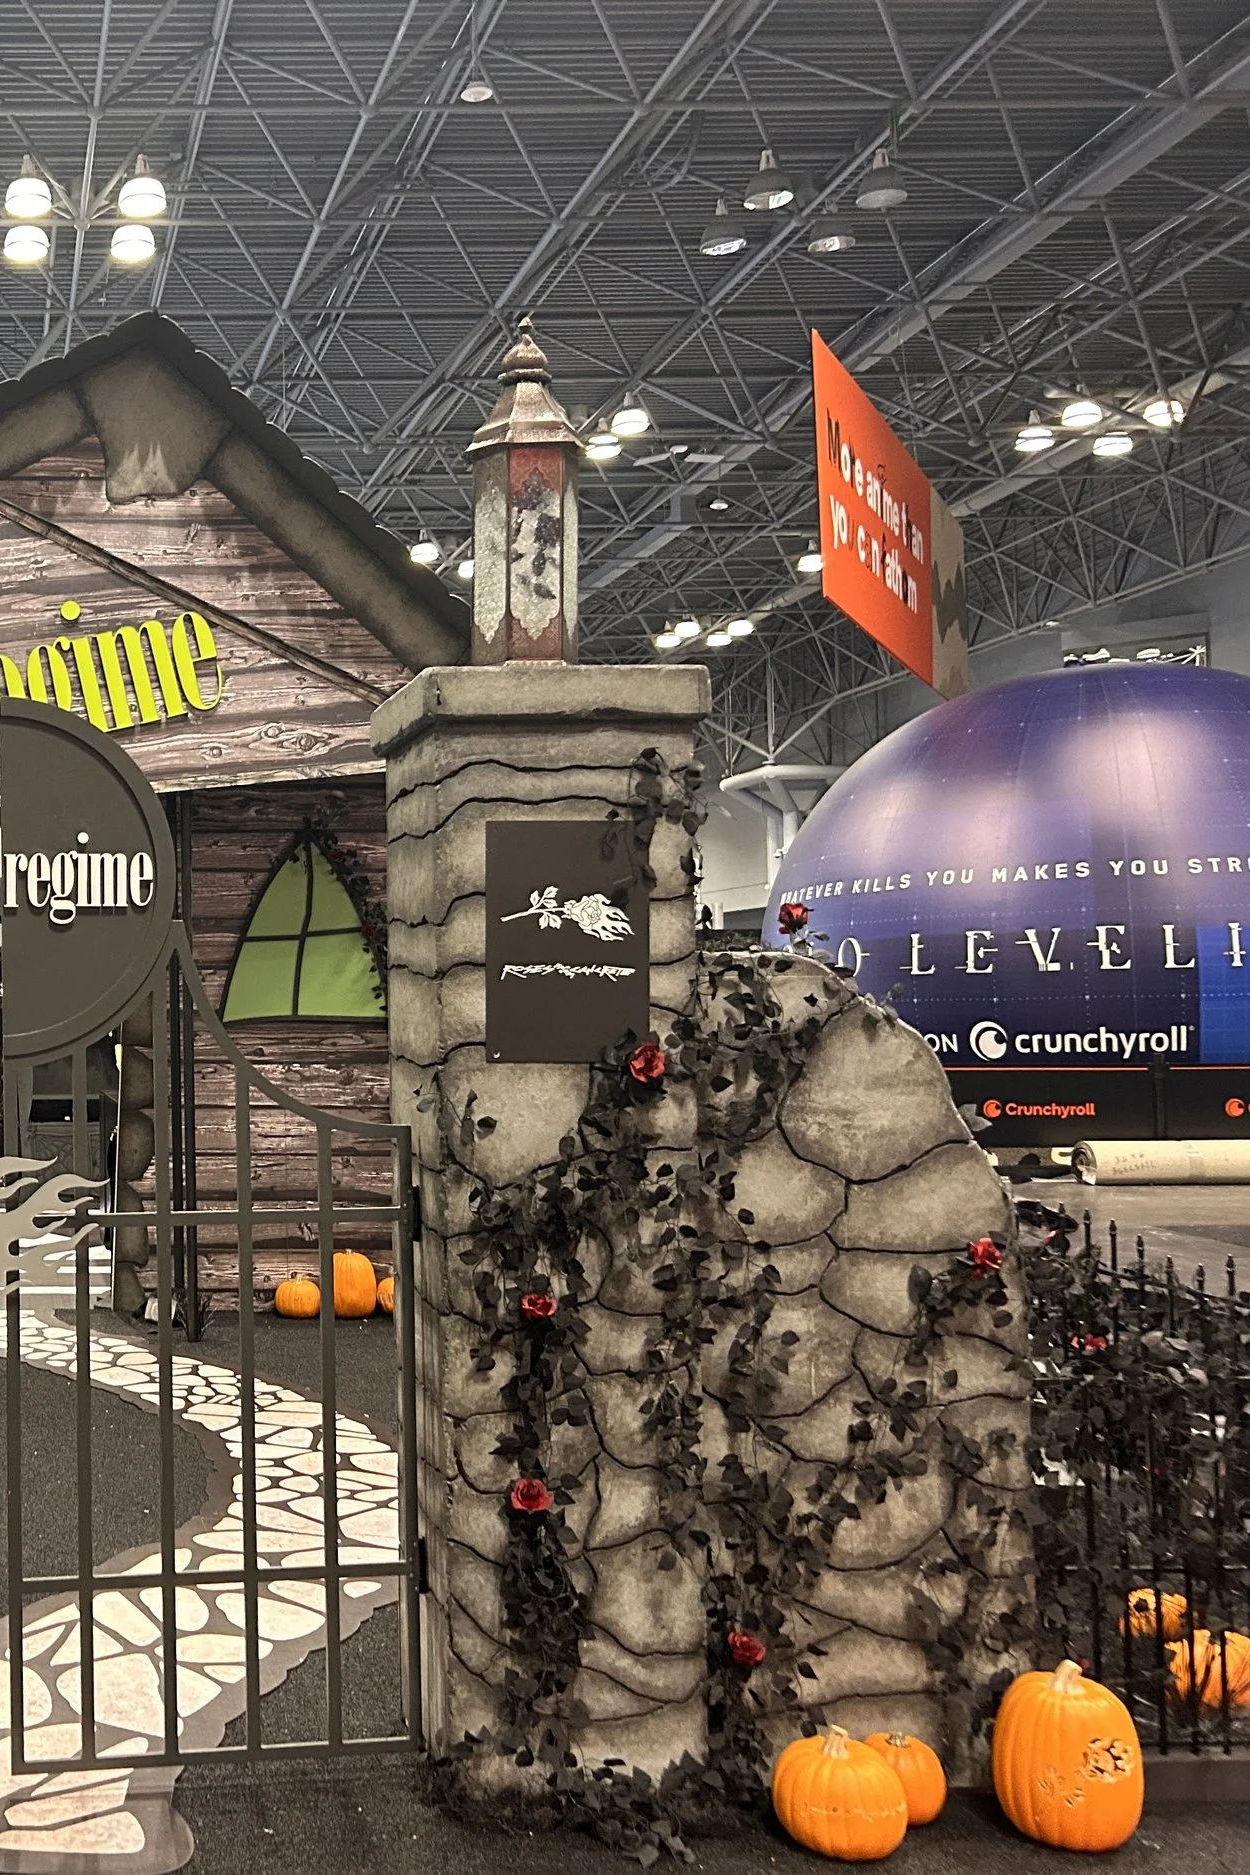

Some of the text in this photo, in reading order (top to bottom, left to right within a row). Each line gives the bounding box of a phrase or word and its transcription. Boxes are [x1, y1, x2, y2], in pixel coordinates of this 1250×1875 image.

[827, 408, 924, 565] More anime than
[829, 494, 918, 614] you can fathom
[3, 832, 154, 925] regime
[779, 857, 1250, 906] WHATEVER KILLS YOU MAKES YOU STR
[1014, 1026, 1188, 1060] crunchyroll
[1005, 1102, 1096, 1118] Crunchyroll
